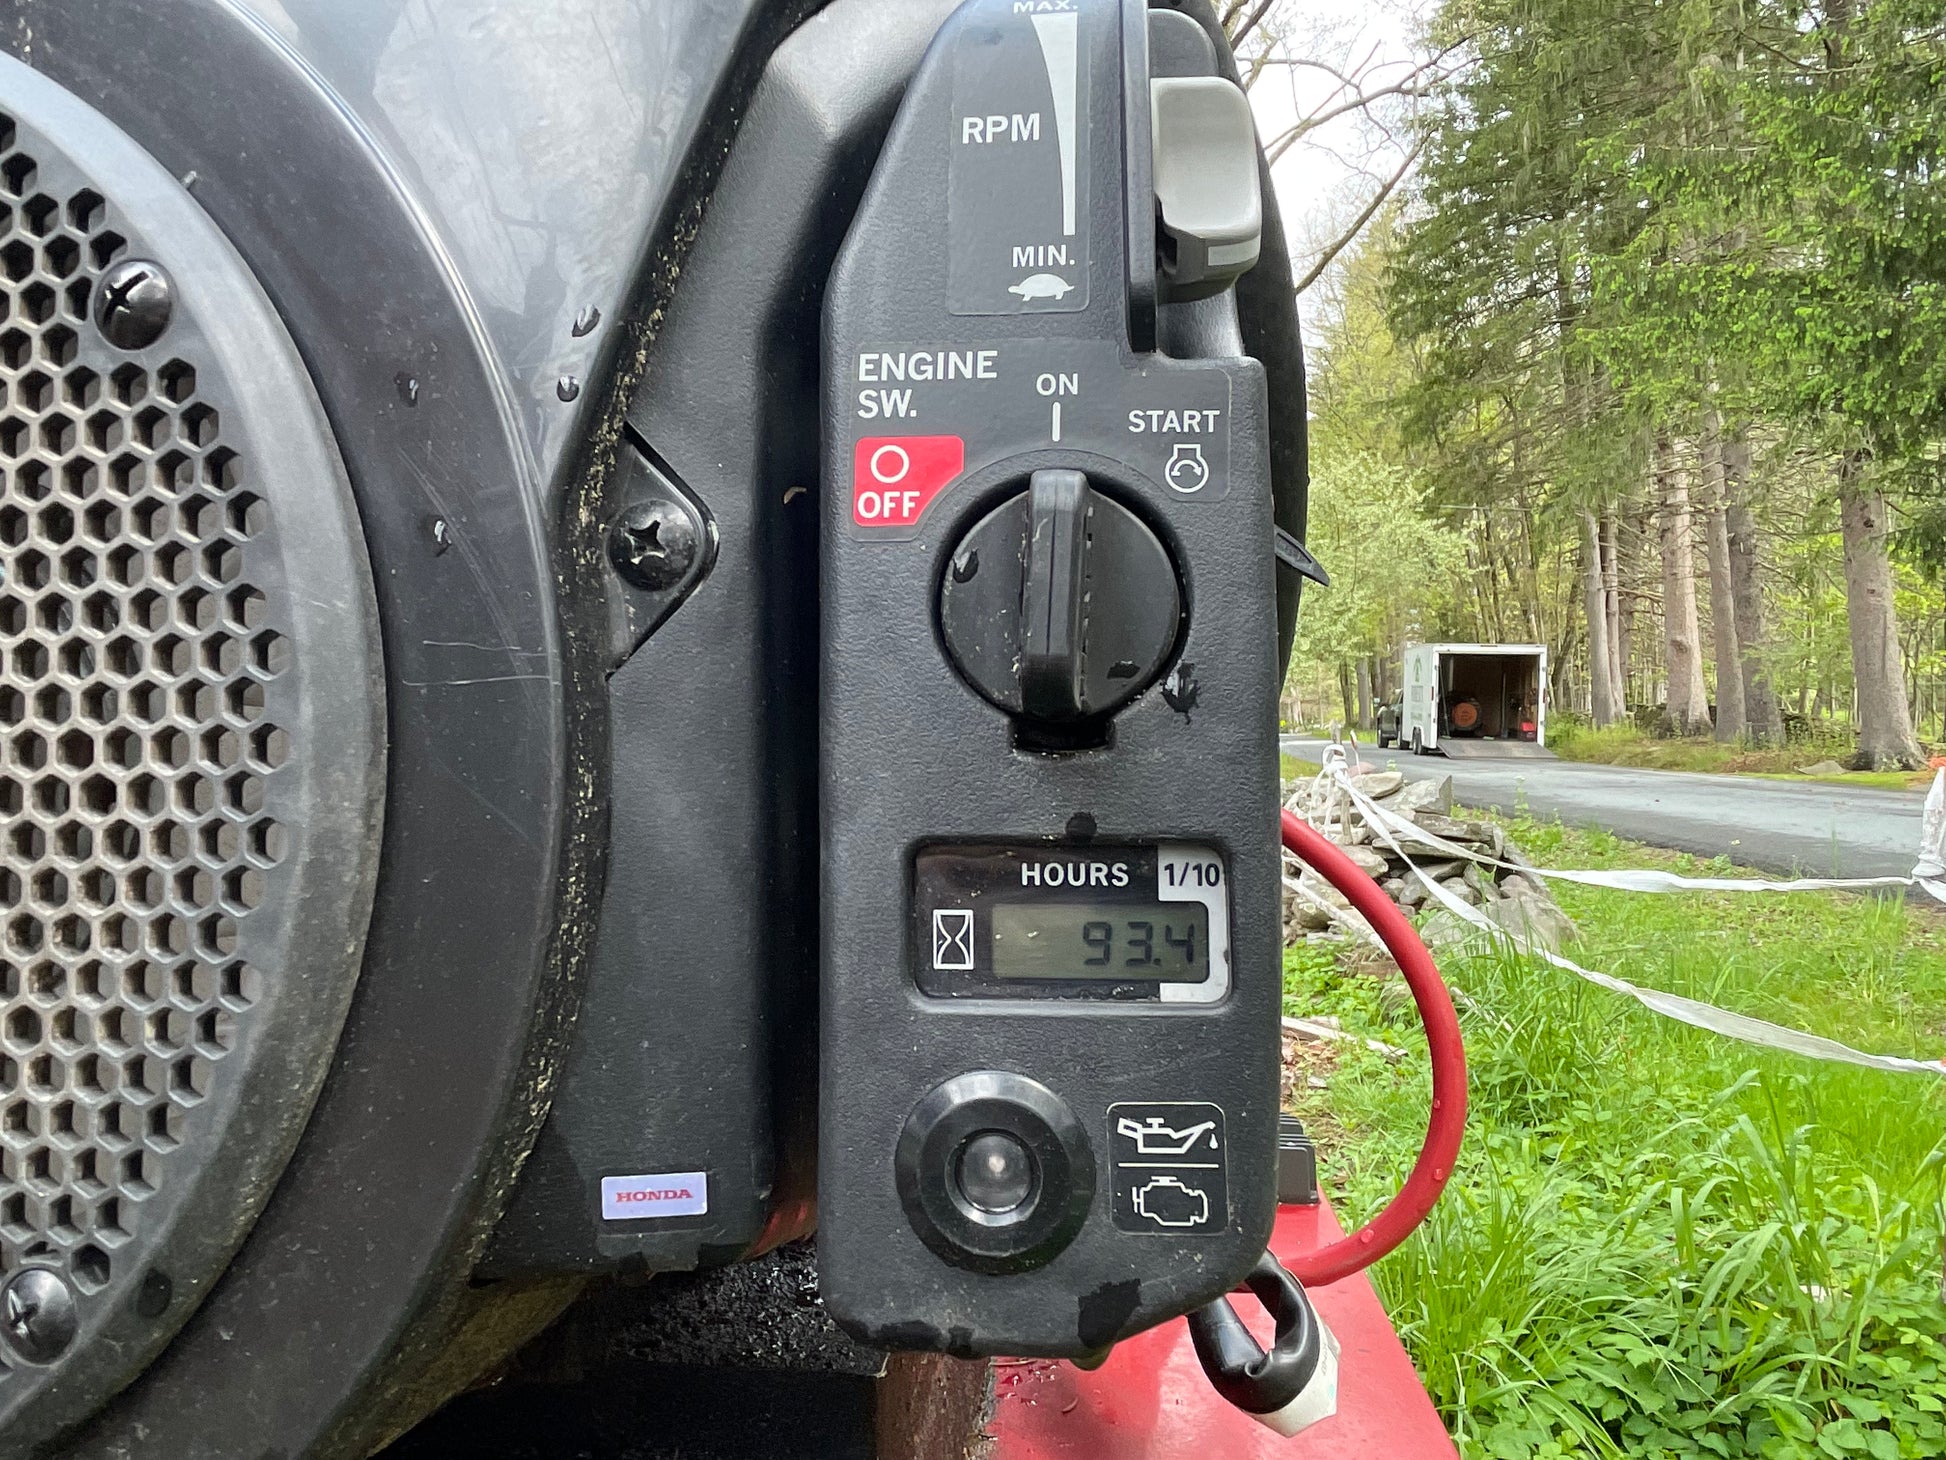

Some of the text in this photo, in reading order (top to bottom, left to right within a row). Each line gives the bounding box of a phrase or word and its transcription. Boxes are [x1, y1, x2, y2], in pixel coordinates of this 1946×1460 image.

[1013, 0, 1078, 13] MAX.
[962, 113, 1040, 144] RPM
[1012, 245, 1075, 268] MIN.
[858, 350, 998, 382] ENGINE
[1036, 373, 1079, 397] ON
[857, 389, 917, 419] SW.
[1128, 410, 1220, 434] START
[857, 491, 920, 519] OFF
[1020, 862, 1130, 887] HOURS
[1163, 862, 1221, 887] 1/10
[1083, 921, 1195, 967] 93.4
[616, 1189, 692, 1203] HONDA
